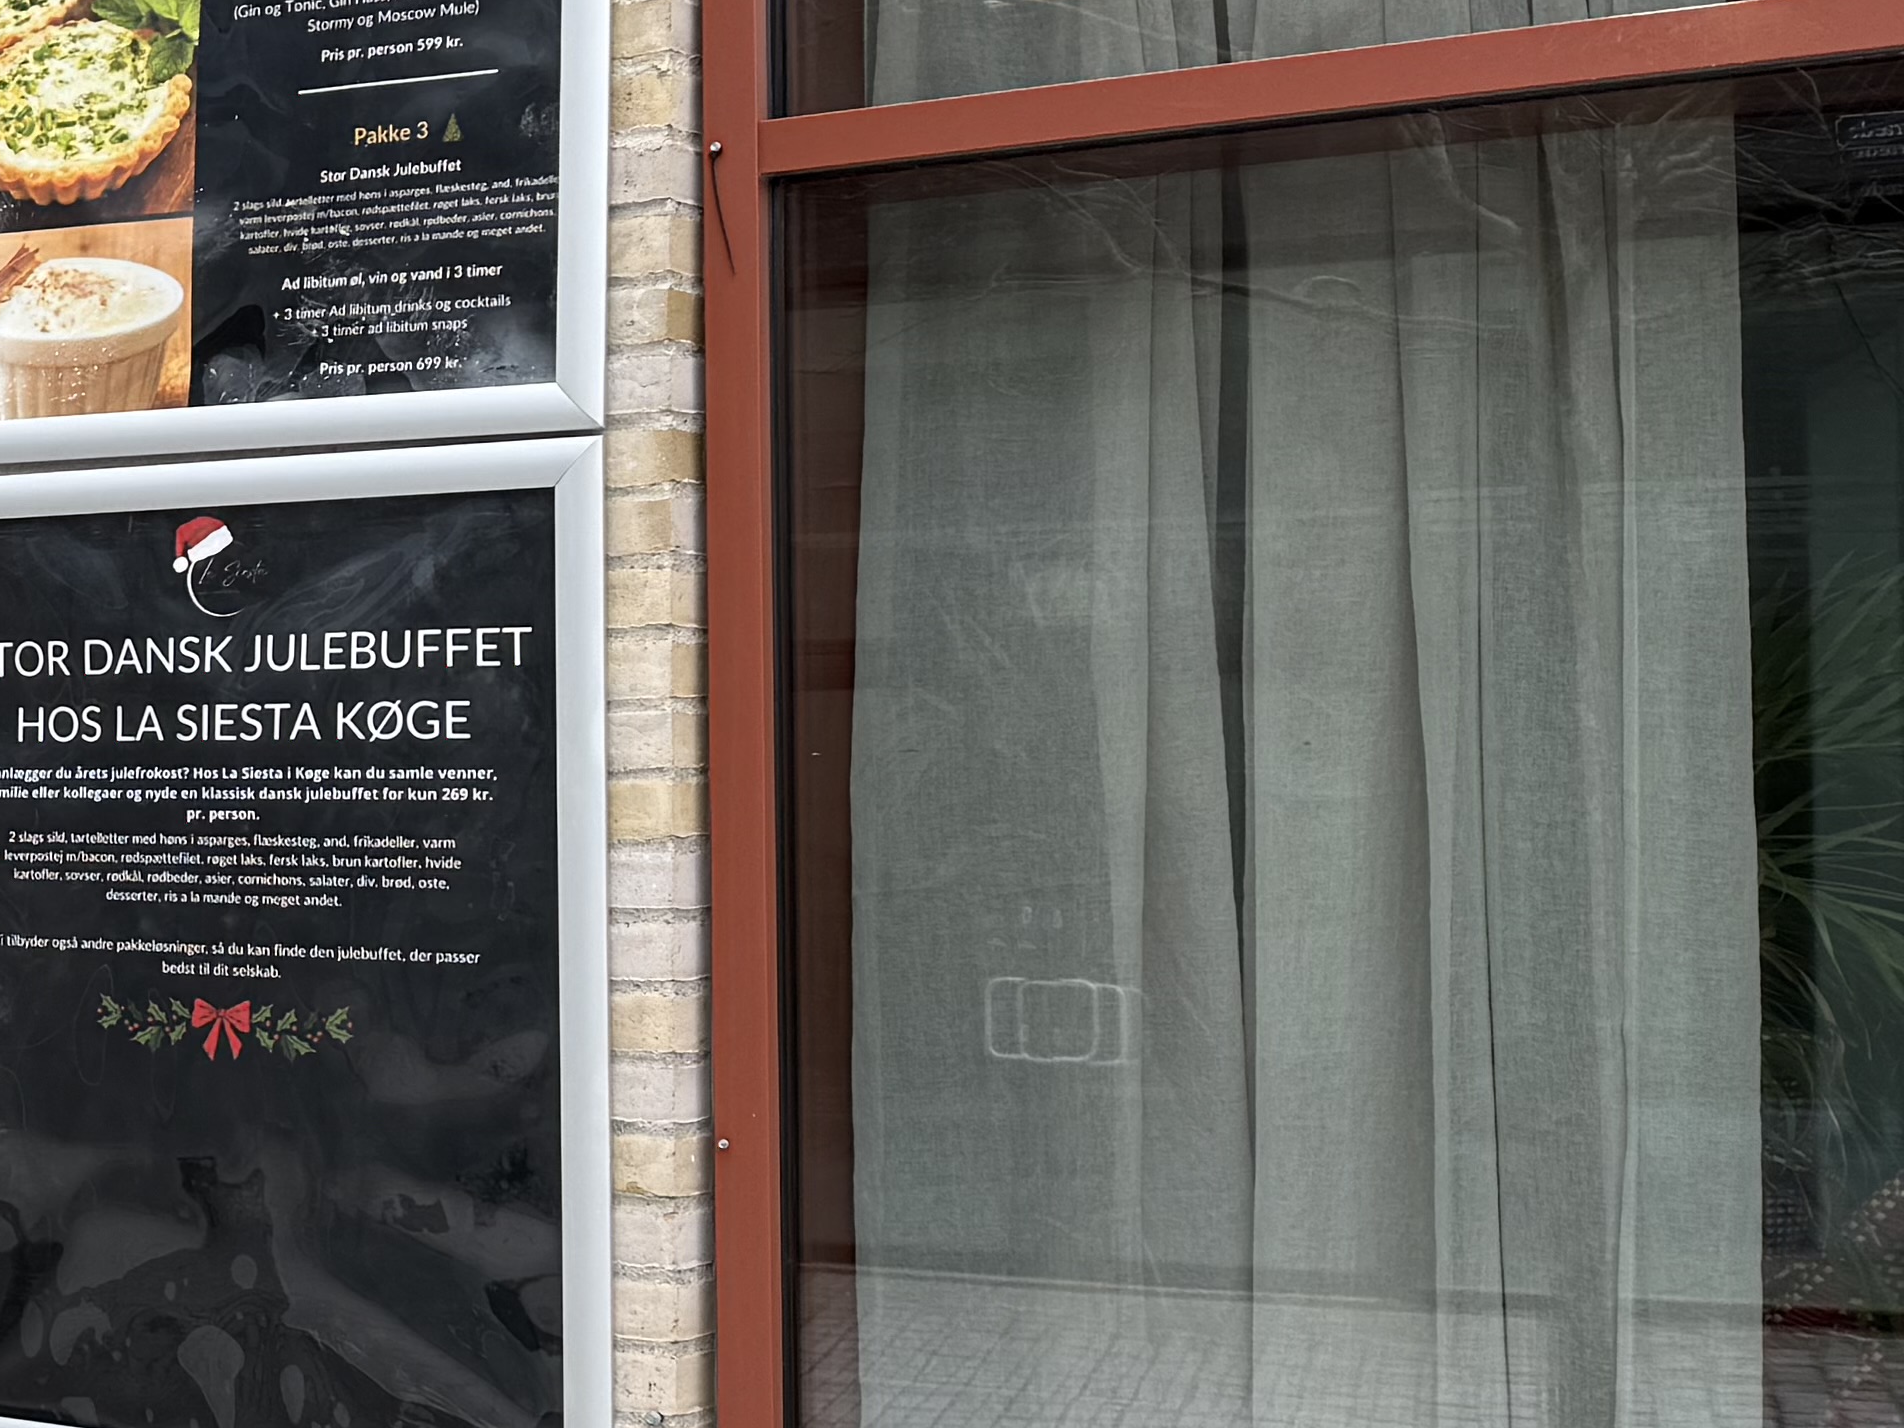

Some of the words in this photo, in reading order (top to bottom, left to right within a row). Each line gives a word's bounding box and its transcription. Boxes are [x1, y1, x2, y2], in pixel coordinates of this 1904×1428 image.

[233, 4, 261, 21] (Gin
[264, 4, 282, 17] og
[307, 17, 355, 33] Stormy
[357, 14, 374, 28] og
[378, 7, 437, 24] Moscow
[440, 0, 480, 17] Mule)
[321, 47, 345, 63] Pris
[347, 48, 364, 61] pr.
[367, 42, 414, 60] person
[416, 36, 443, 52] 599
[445, 35, 464, 49] kr.
[354, 123, 411, 145] Pakke
[416, 121, 429, 139] 3
[320, 170, 347, 184] Stor
[349, 164, 390, 181] Dansk
[393, 158, 462, 177] Julebuffet
[319, 361, 344, 375] Pris
[346, 363, 365, 377] pr.
[367, 361, 413, 376] person
[416, 356, 442, 371] 699
[444, 355, 462, 369] kr.
[84, 635, 233, 675] DANSK
[244, 626, 533, 673] JULEBUFFET
[17, 705, 102, 743] HOS
[116, 705, 164, 742] LA
[176, 702, 322, 742] SIESTA
[336, 699, 471, 743] KØGE
[55, 766, 72, 779] du
[74, 765, 108, 780] årets
[110, 766, 190, 783] julefrokost?
[193, 767, 219, 780] Hos
[222, 767, 238, 780] La
[241, 766, 284, 780] Siesta
[287, 766, 291, 780] i
[295, 766, 330, 783] Køge
[333, 765, 362, 780] kan
[365, 765, 385, 779] du
[388, 766, 434, 780] samle
[31, 785, 61, 799] eller
[63, 785, 124, 803] kollegaer
[125, 789, 143, 803] og
[145, 786, 178, 803] nyde
[180, 789, 198, 800] en
[201, 786, 255, 800] klassisk
[258, 786, 302, 800] dansk
[304, 786, 379, 804] julebuffet
[382, 787, 405, 801] for
[407, 787, 438, 801] kun
[441, 787, 469, 801] 269
[472, 787, 493, 801] kr.
[186, 809, 206, 823] pr.
[209, 809, 260, 824] person.
